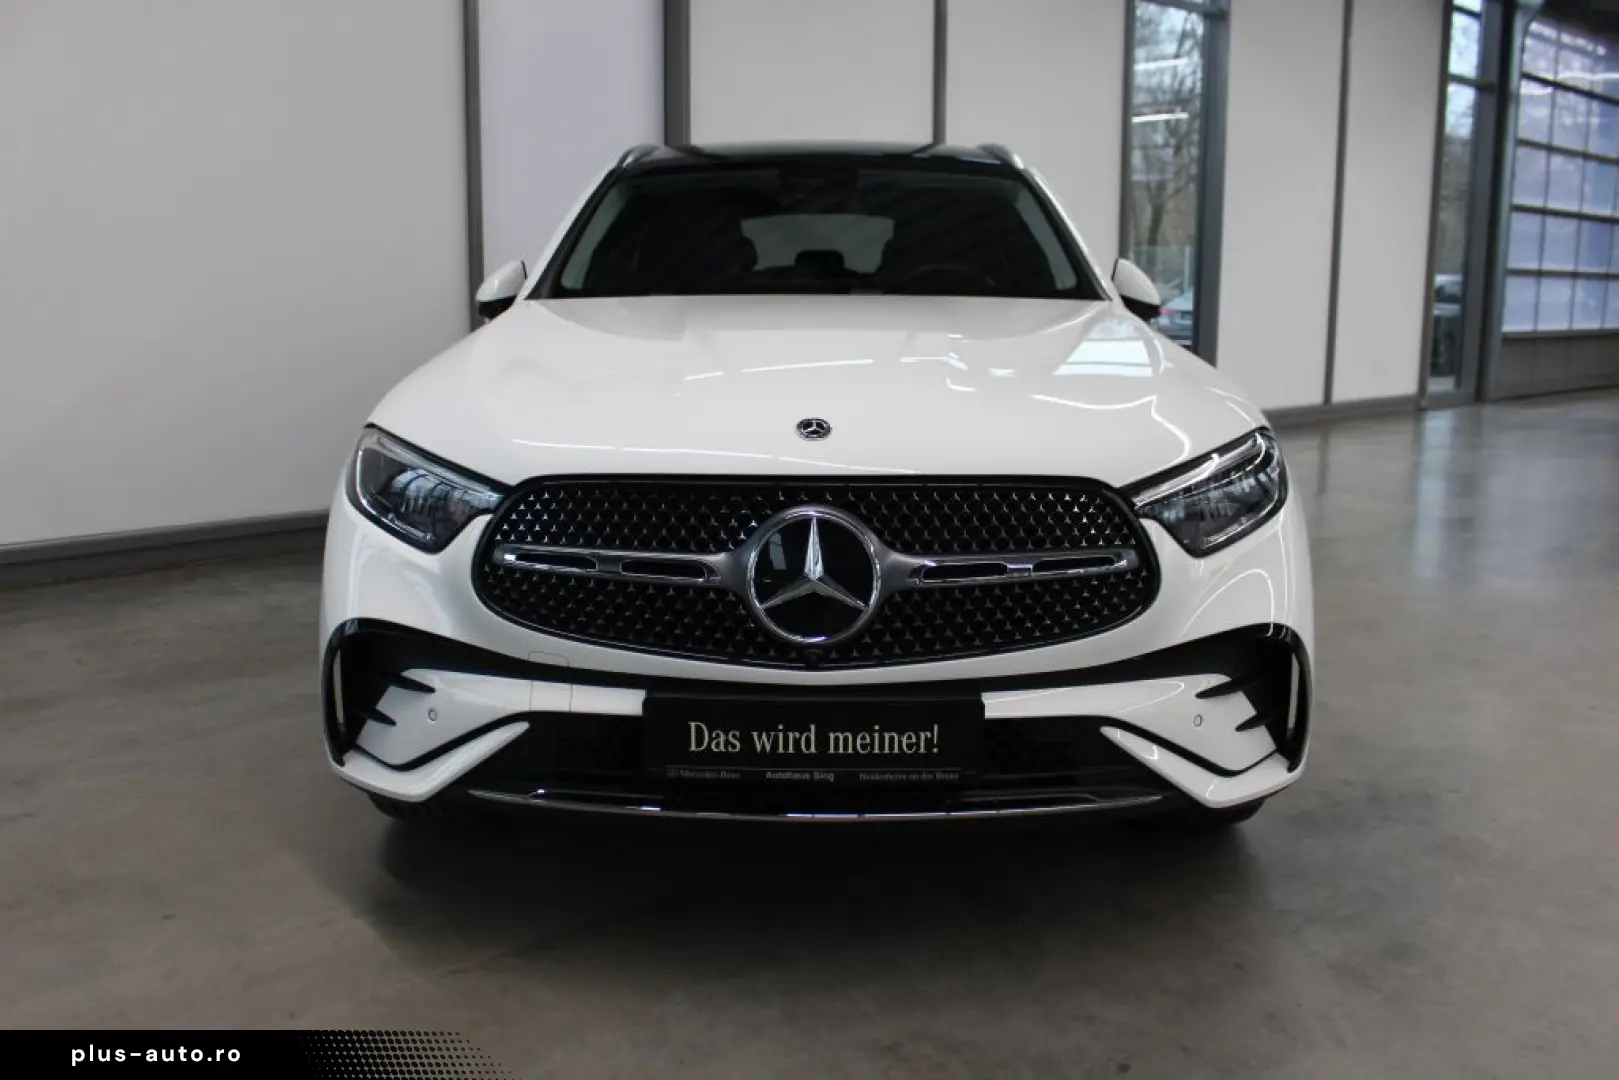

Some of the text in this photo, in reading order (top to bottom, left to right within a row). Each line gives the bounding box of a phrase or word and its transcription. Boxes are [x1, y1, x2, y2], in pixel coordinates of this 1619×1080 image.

[688, 722, 939, 754] Das wird meiner!
